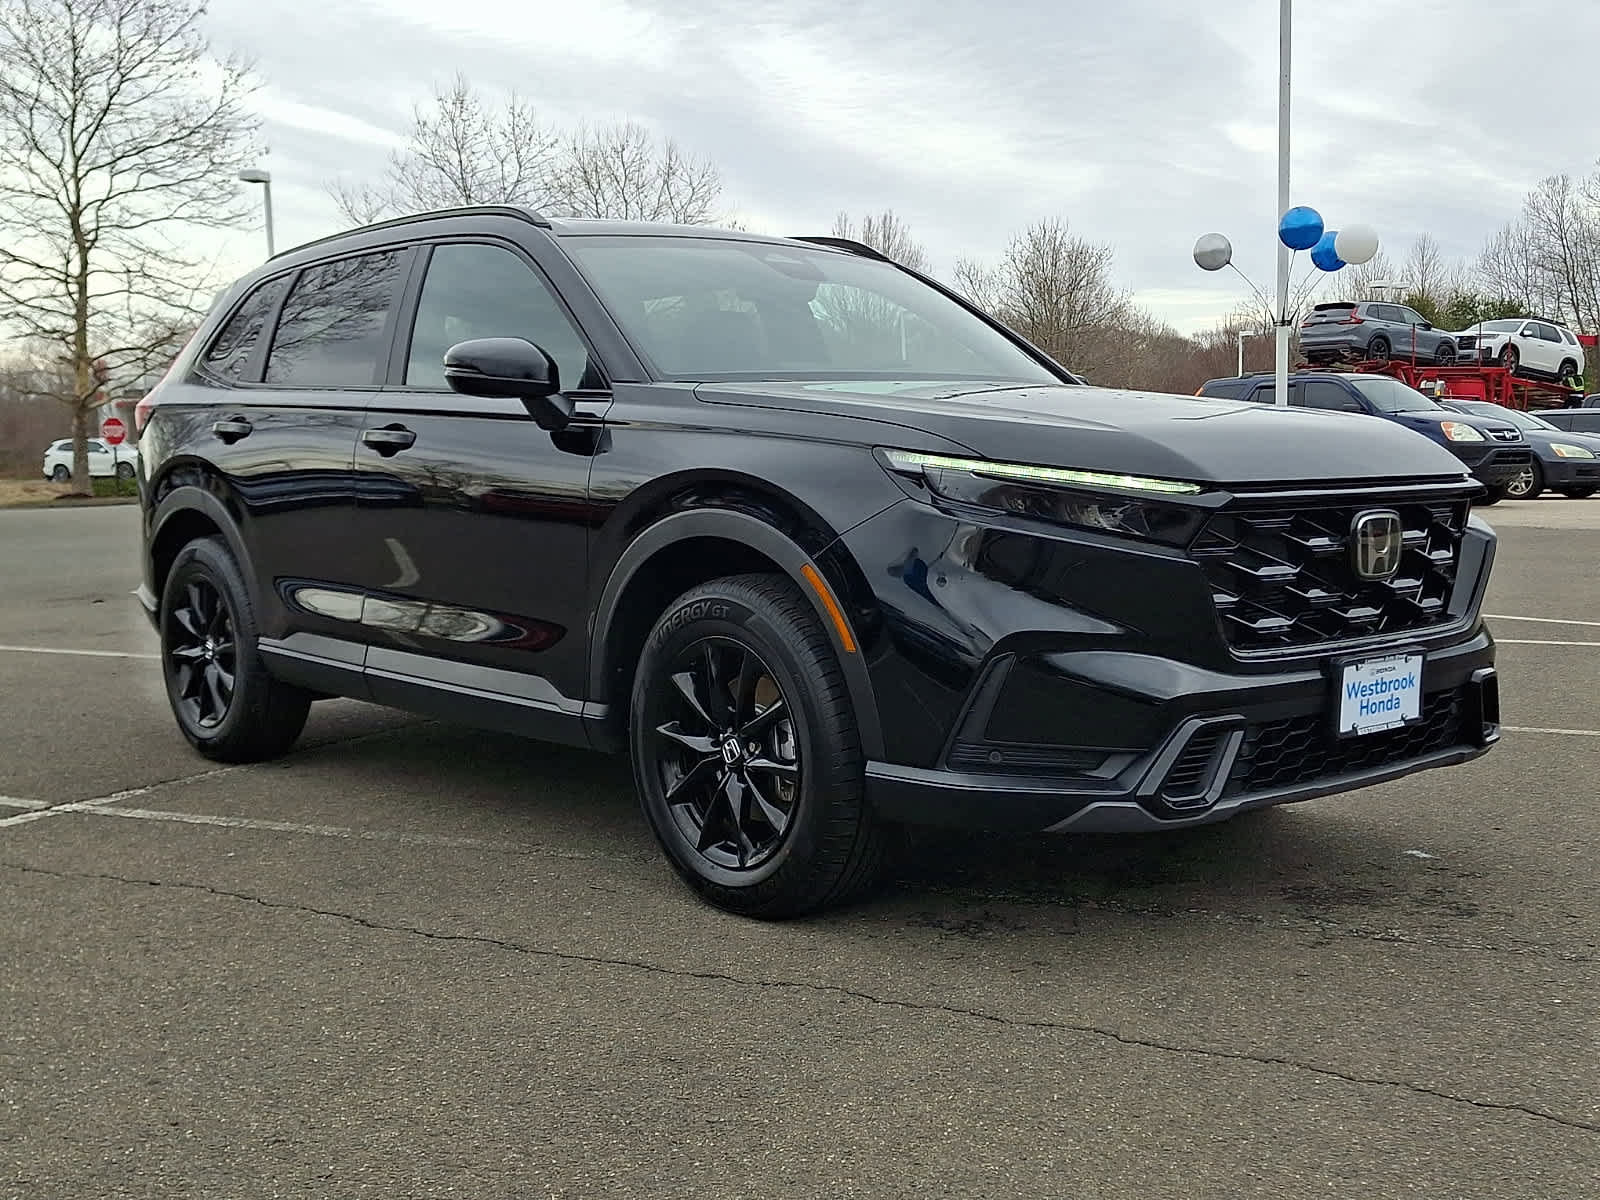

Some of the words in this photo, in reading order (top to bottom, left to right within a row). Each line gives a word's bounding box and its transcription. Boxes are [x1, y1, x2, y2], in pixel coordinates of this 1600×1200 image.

[712, 604, 729, 618] GT
[1346, 672, 1415, 699] Westbrook
[1359, 694, 1401, 716] Honda
